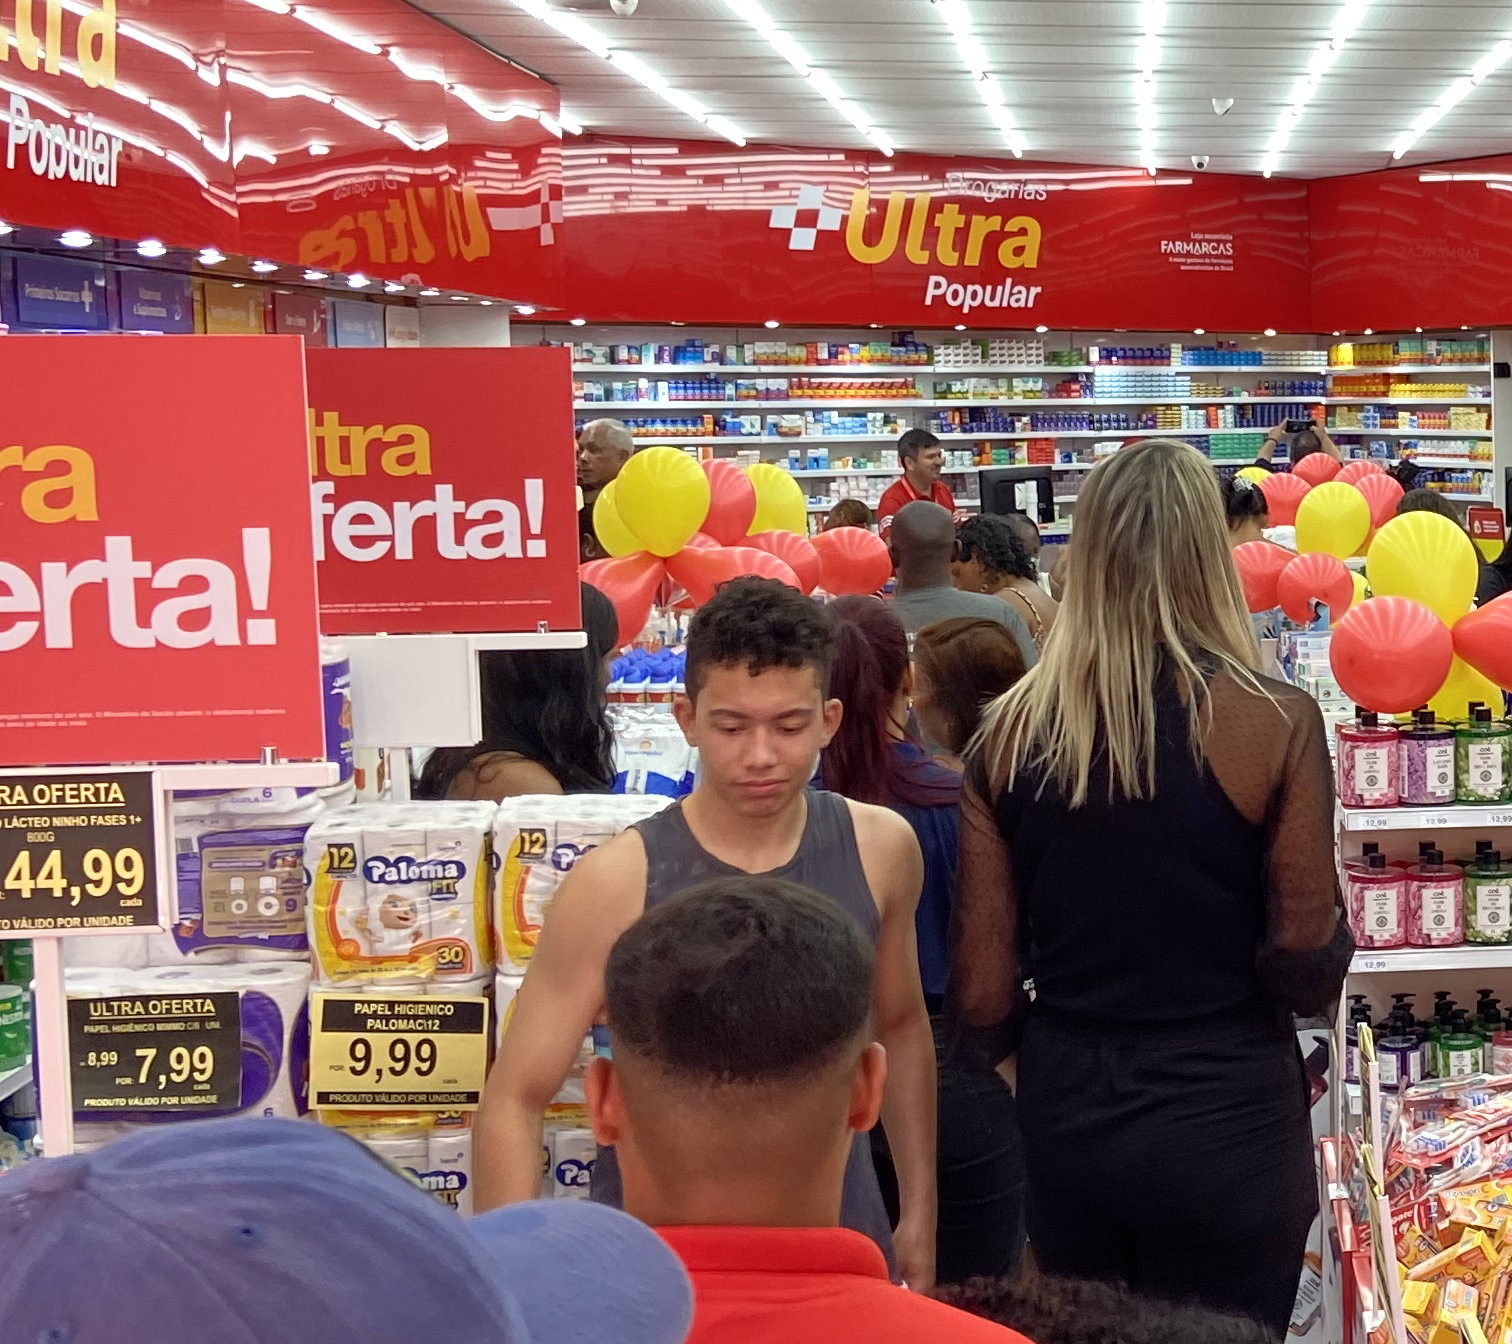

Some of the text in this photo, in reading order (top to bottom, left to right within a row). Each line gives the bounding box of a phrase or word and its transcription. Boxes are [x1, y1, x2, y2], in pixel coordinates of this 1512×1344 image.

[7, 94, 122, 187] Popular
[948, 174, 1047, 202] Drogarias
[846, 188, 1042, 269] Ultra
[1160, 240, 1234, 255] FARMARCAS
[925, 275, 1042, 314] Popular
[33, 783, 125, 804] OFERTA
[5, 816, 50, 828] LÁCTEO
[52, 816, 87, 827] NINHO
[90, 815, 127, 826] FASES
[27, 832, 55, 843] 800G
[521, 830, 546, 855] 12
[329, 846, 354, 870] 12
[4, 848, 144, 906] 44,99
[366, 859, 459, 883] Paloma
[13, 915, 135, 929] VÁLIDO POR UNIDADE
[437, 946, 464, 964] 30
[90, 999, 216, 1016] ULTRA OFERTA
[354, 1003, 455, 1016] PAPEL HIGIENICO
[87, 1052, 118, 1068] 8,99
[135, 1046, 214, 1090] 7,99
[349, 1037, 438, 1084] 9,99
[84, 1094, 218, 1106] PRODUTO VÁLIDO POR UNIDADE
[329, 1093, 468, 1103] PRODUTO VÁLIDO POR UNIDADE
